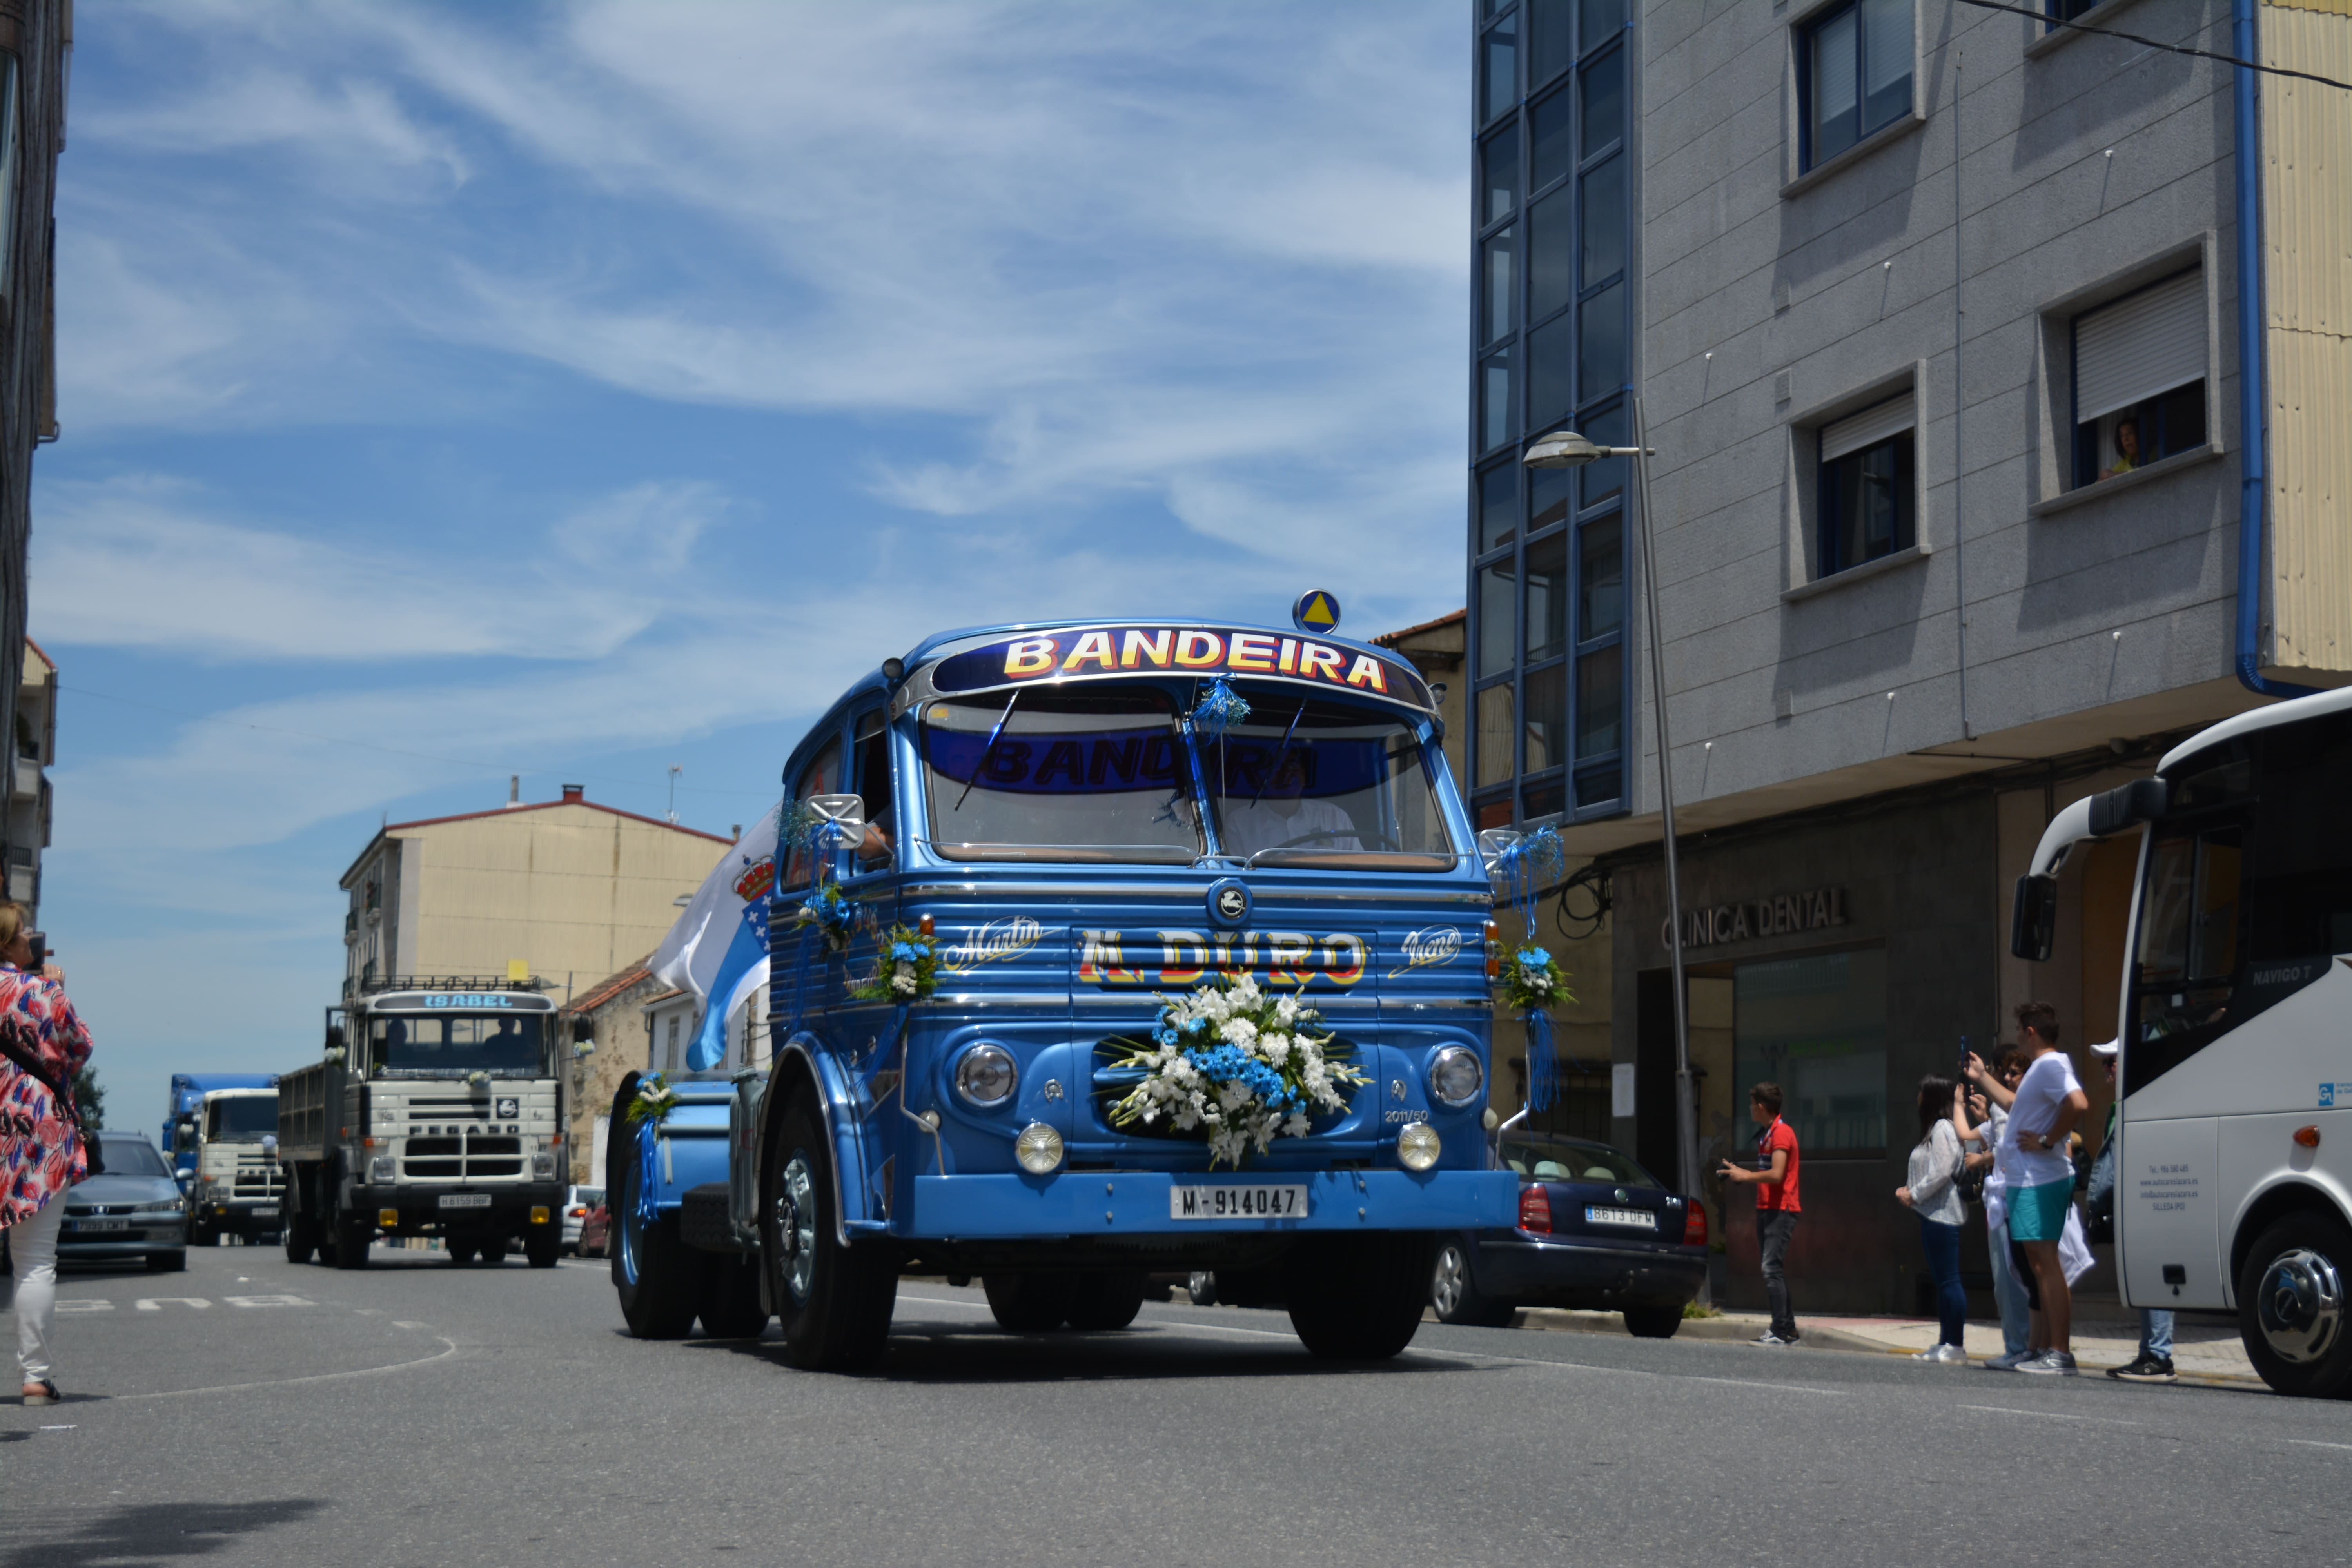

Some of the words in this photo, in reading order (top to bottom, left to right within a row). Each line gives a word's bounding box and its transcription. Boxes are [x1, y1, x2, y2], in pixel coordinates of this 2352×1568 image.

[1003, 629, 1388, 694] BANDEIRA
[1661, 903, 1748, 951] CINICA
[1759, 888, 1845, 936] DENTAL
[1398, 927, 1461, 967] Irene
[1156, 931, 1366, 985] DURO
[2253, 966, 2300, 985] NAVIGO
[2303, 965, 2312, 979] T
[425, 994, 513, 1008] ISABEL
[1385, 1109, 1429, 1123] 2011/50
[2170, 1164, 2178, 1172] 580
[2180, 1164, 2189, 1172] 485
[1183, 1189, 1296, 1216] M-914047
[2152, 1201, 2174, 1210] SILLEDA
[2174, 1201, 2185, 1210] (PO)
[1594, 1207, 1625, 1222] 8613
